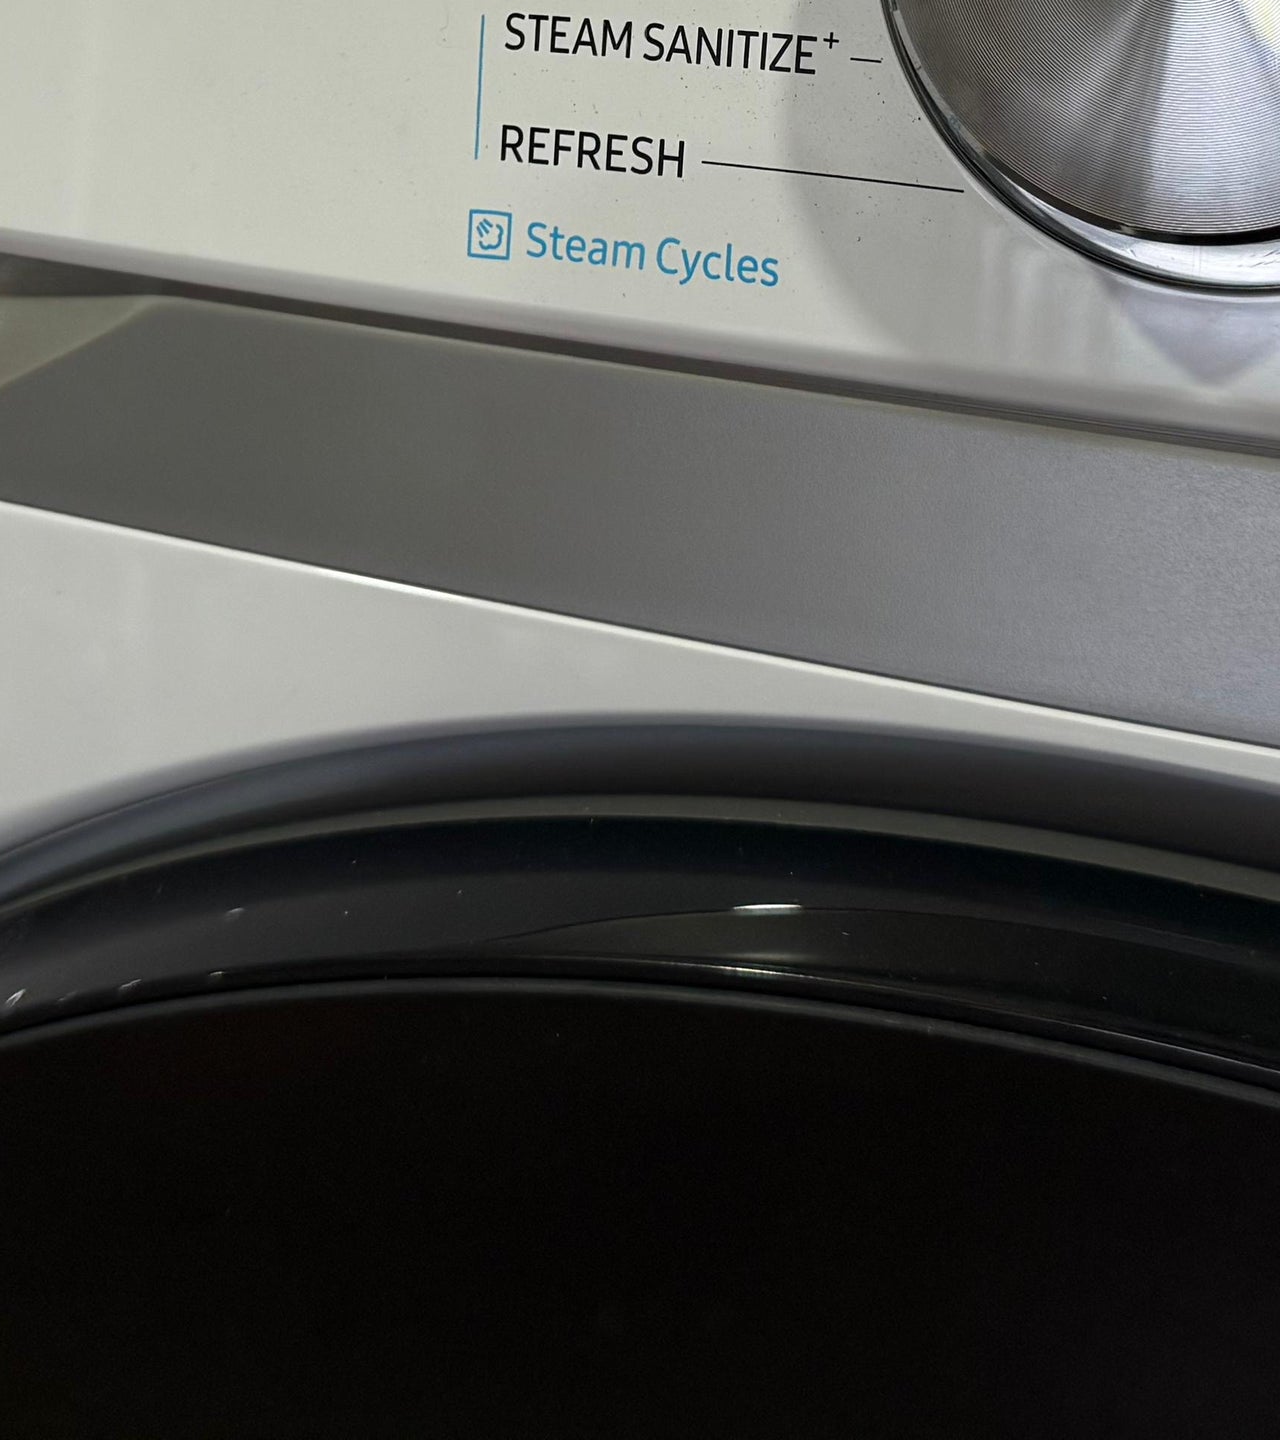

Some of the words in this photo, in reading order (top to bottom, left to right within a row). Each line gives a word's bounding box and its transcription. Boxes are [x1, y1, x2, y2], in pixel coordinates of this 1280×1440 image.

[504, 11, 633, 60] STEAM
[499, 123, 686, 179] REFRESH
[526, 221, 647, 272] Steam
[656, 236, 780, 288] Cycles
